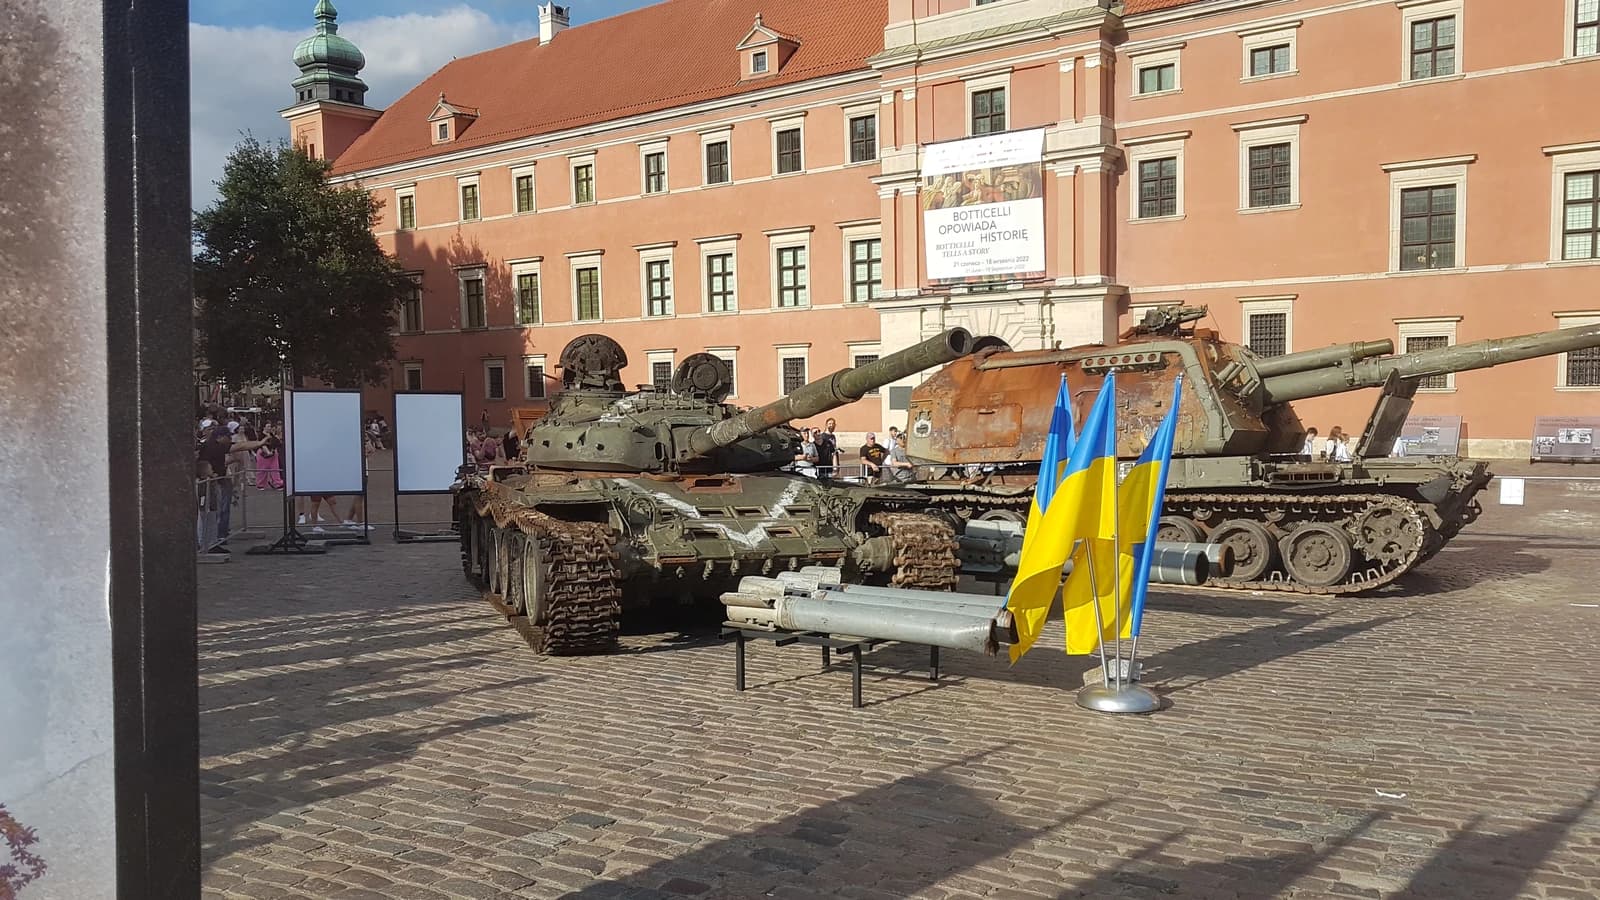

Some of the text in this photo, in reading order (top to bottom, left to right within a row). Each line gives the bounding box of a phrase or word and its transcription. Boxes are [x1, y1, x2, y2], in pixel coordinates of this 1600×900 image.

[953, 206, 1011, 221] BOTTICELLI
[938, 220, 997, 235] OPOWIADA
[980, 229, 1029, 243] HISTORIĘ
[936, 240, 975, 250] BOTTICELLI
[942, 250, 961, 258] TELLS
[968, 247, 990, 256] STORY
[1015, 255, 1029, 263] 2022
